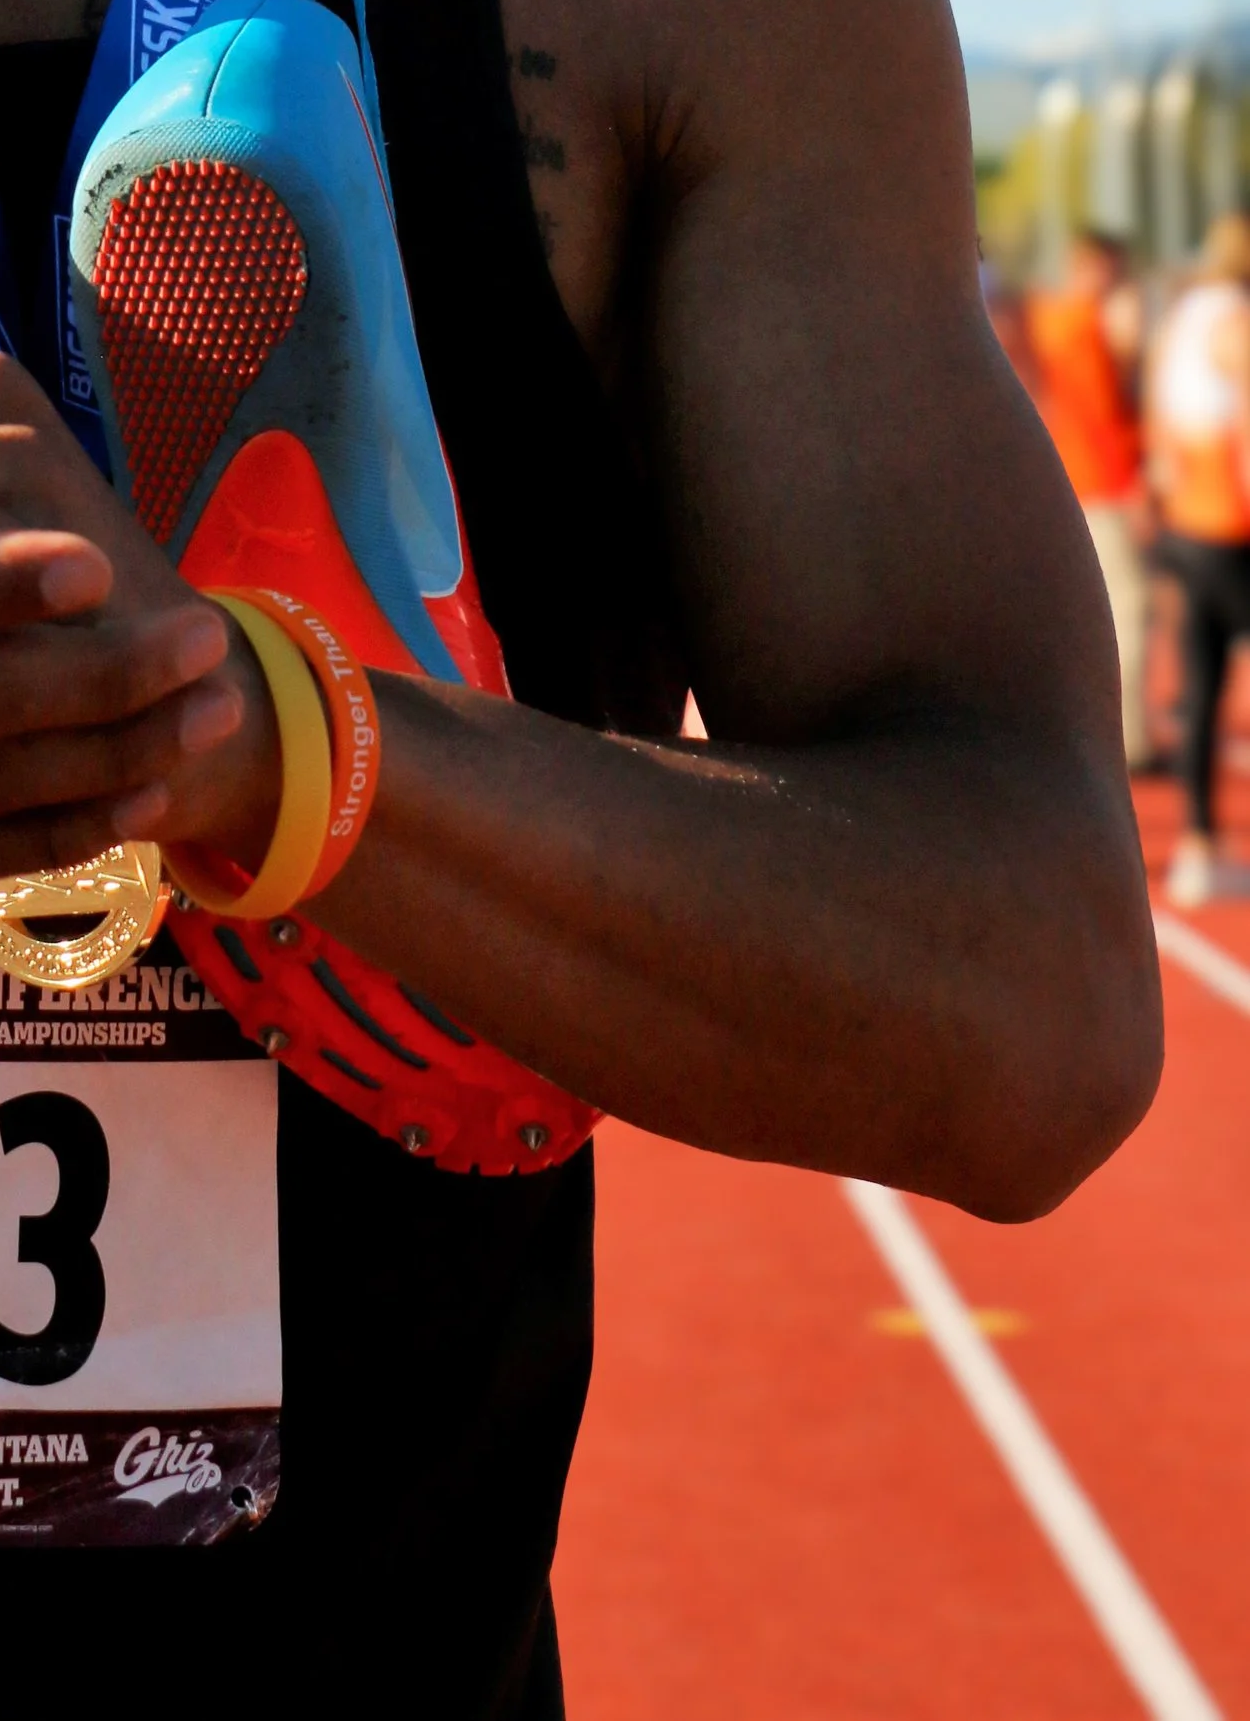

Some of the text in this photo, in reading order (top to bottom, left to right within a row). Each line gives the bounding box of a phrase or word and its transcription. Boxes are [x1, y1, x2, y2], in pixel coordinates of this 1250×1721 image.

[304, 617, 354, 681] Than
[331, 690, 374, 838] Stronger
[114, 1426, 222, 1494] Griz
